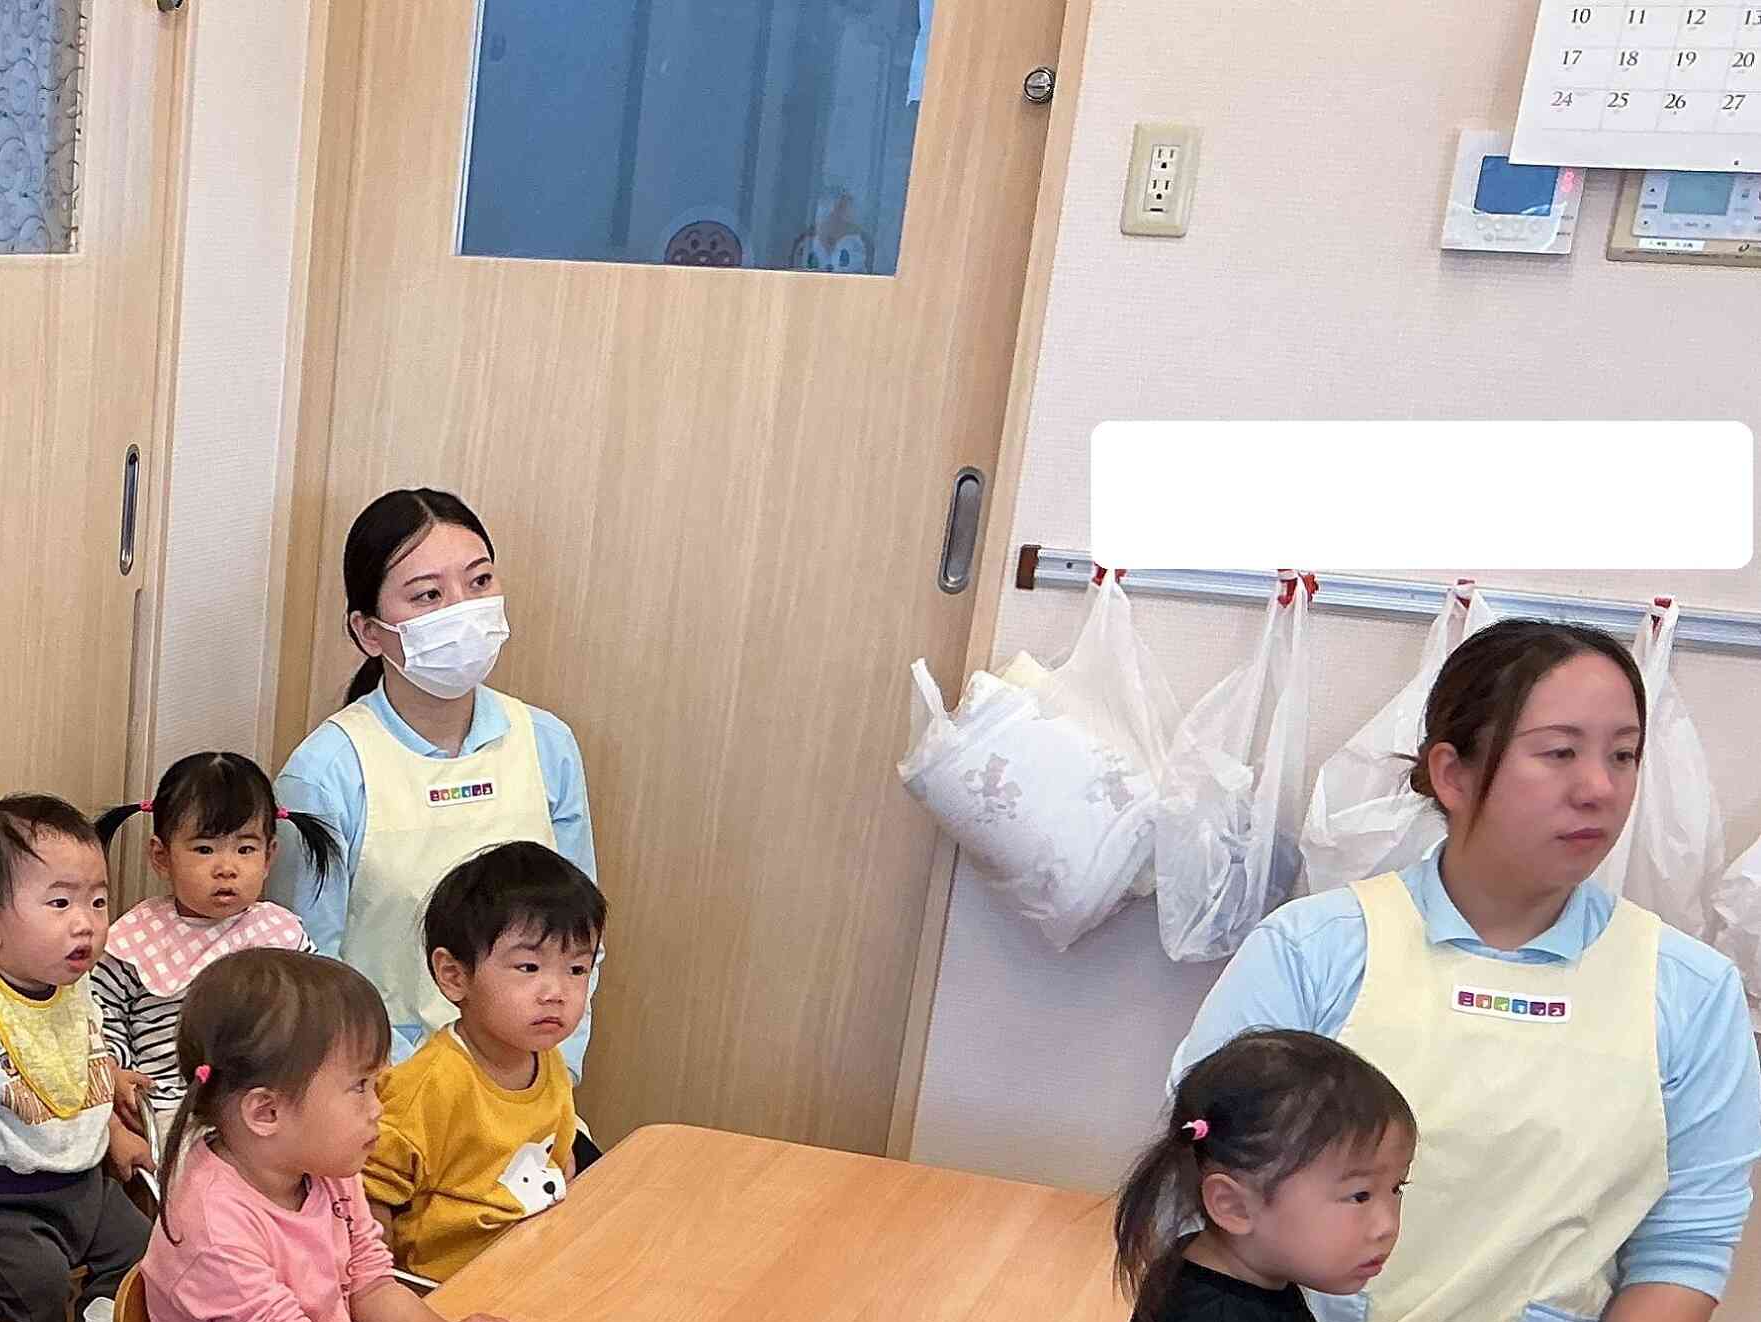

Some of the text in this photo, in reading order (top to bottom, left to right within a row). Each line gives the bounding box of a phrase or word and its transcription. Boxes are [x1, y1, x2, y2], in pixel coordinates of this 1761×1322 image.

[1571, 8, 1591, 24] 10
[1628, 9, 1646, 24] 11
[1687, 9, 1707, 25] 12
[1562, 49, 1755, 68] 17 18 19 20
[1551, 91, 1746, 110] 24 25 26 27
